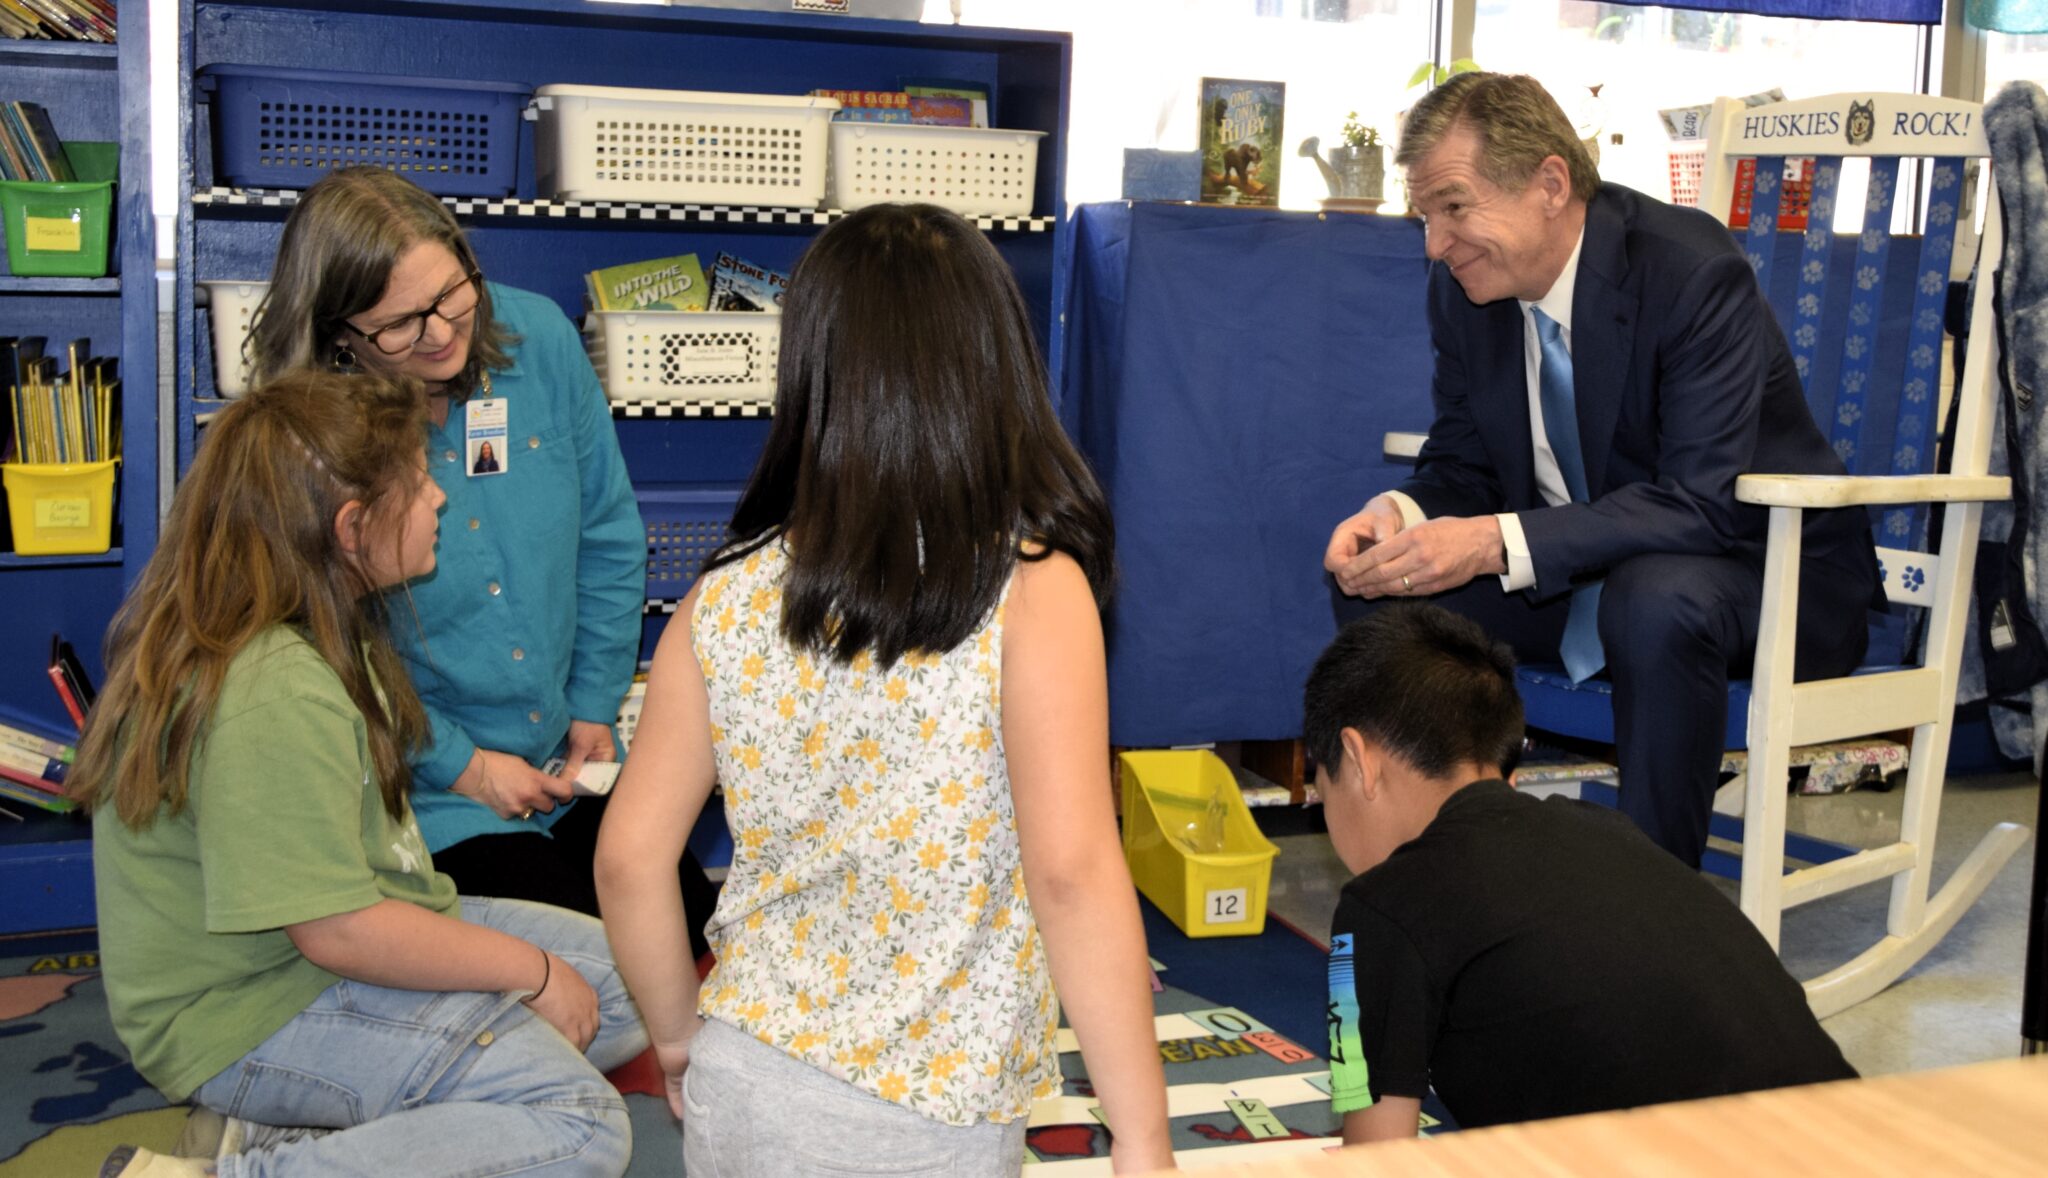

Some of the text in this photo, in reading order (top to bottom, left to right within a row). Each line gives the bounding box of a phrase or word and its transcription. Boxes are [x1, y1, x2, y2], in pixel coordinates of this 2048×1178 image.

[864, 91, 909, 105] SACHAR
[1231, 90, 1253, 109] ONE
[1220, 116, 1267, 144] RUBY
[1743, 111, 1972, 139] HUSKIES ROCK!
[614, 265, 682, 298] INTO THE
[634, 273, 693, 307] WILD
[1214, 894, 1238, 916] 12
[1159, 1038, 1256, 1064] EAN
